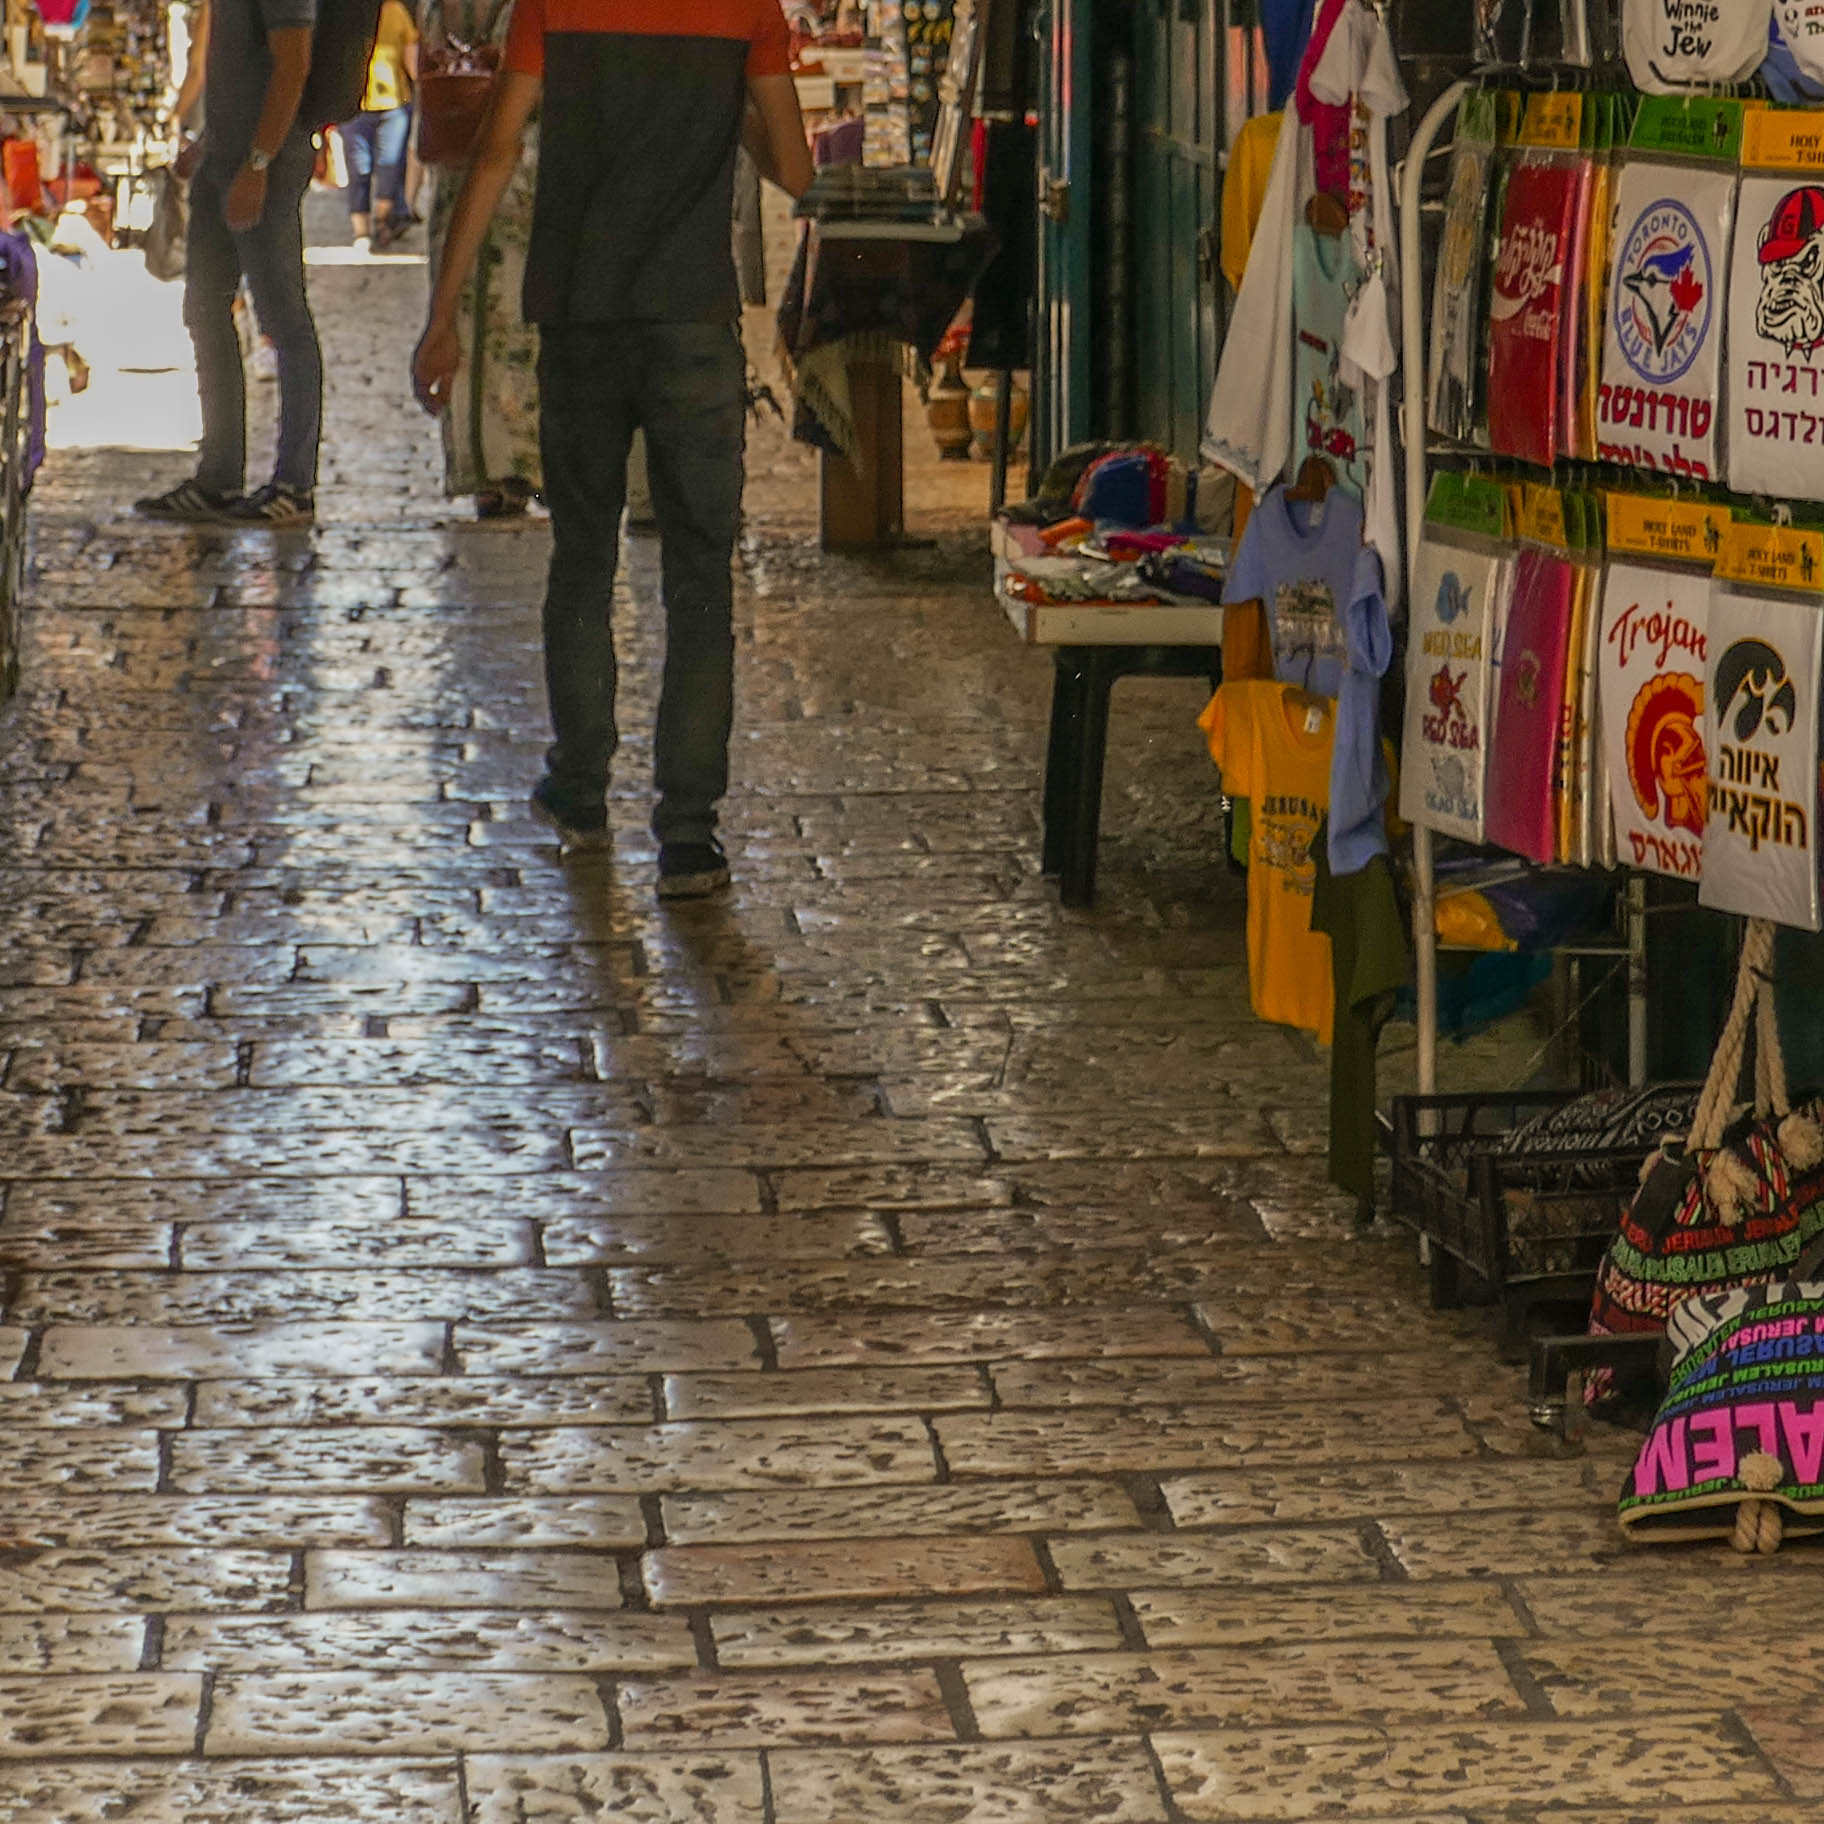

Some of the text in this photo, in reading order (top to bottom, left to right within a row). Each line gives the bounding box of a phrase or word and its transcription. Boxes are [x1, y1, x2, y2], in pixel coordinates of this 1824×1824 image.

[1662, 26, 1713, 59] Jew
[1684, 21, 1704, 33] the
[1790, 135, 1821, 150] HOLY
[1626, 208, 1690, 265] TORONTO
[1619, 304, 1699, 372] BLUE JAYS
[1608, 600, 1708, 669] Trojan
[1719, 744, 1780, 793] איווה
